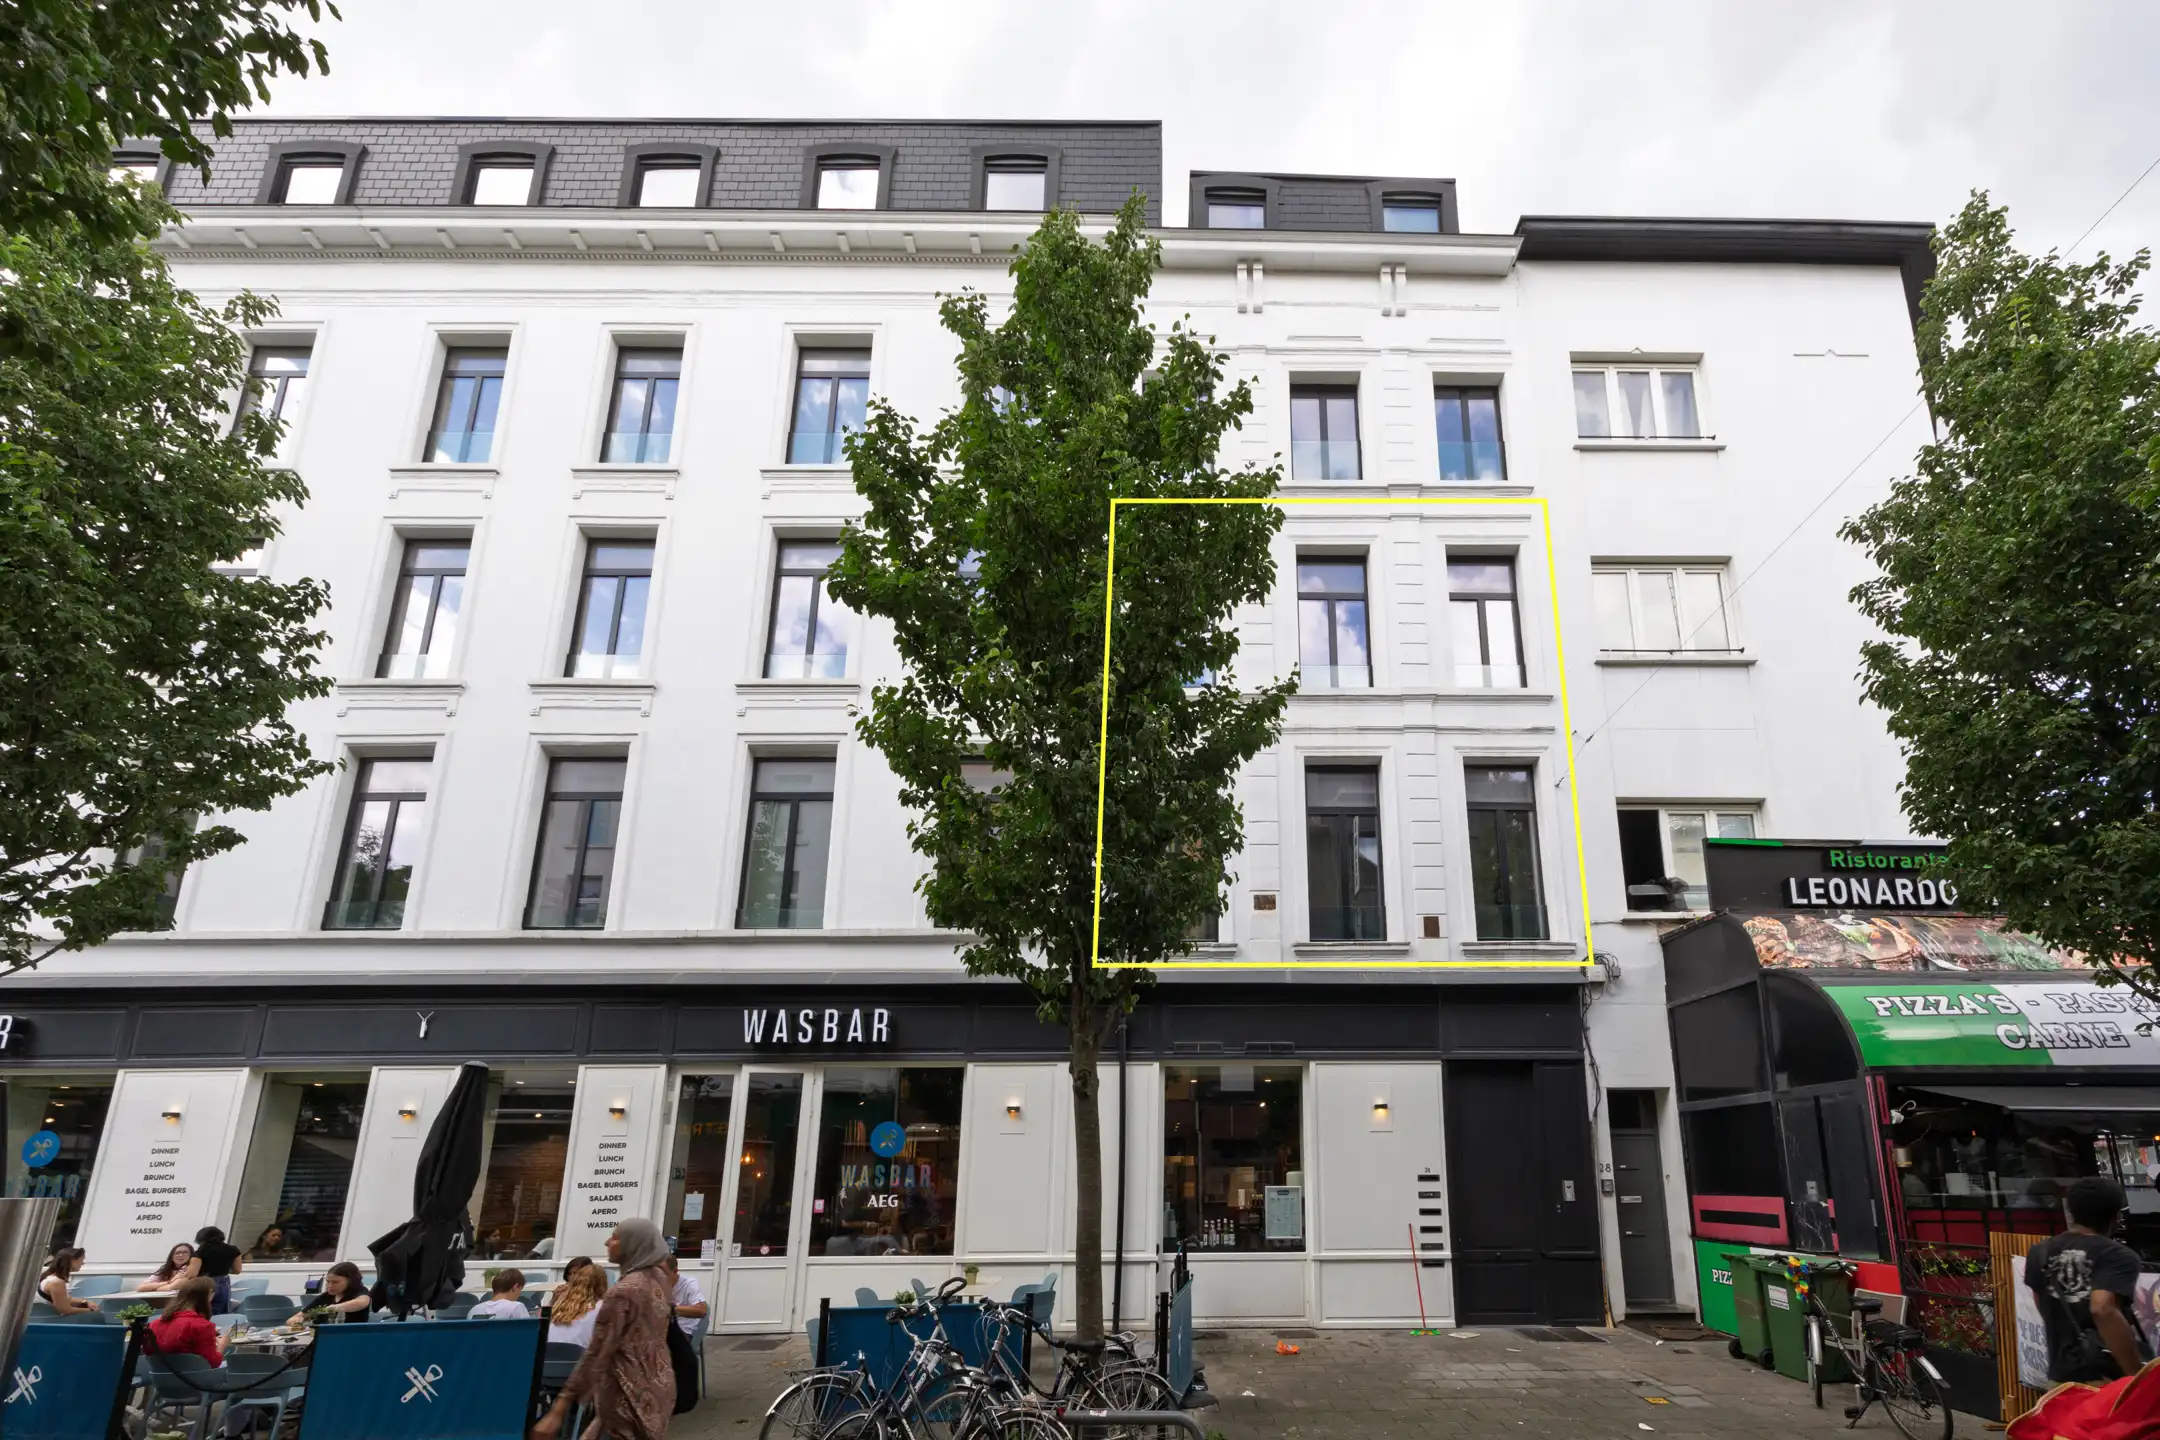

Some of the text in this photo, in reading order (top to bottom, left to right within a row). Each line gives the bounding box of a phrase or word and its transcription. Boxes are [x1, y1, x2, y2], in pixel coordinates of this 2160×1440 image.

[1789, 877, 1959, 906] LEONARDO
[1865, 993, 2022, 1017] PIZZA'S
[743, 1008, 889, 1043] WASBAR
[1996, 1021, 2131, 1050] CARNE
[840, 1164, 932, 1189] WASBAR
[1599, 1163, 1612, 1173] 28
[589, 1194, 624, 1202] SALADES
[867, 1194, 899, 1208] AEG
[587, 1221, 620, 1229] WASSEN
